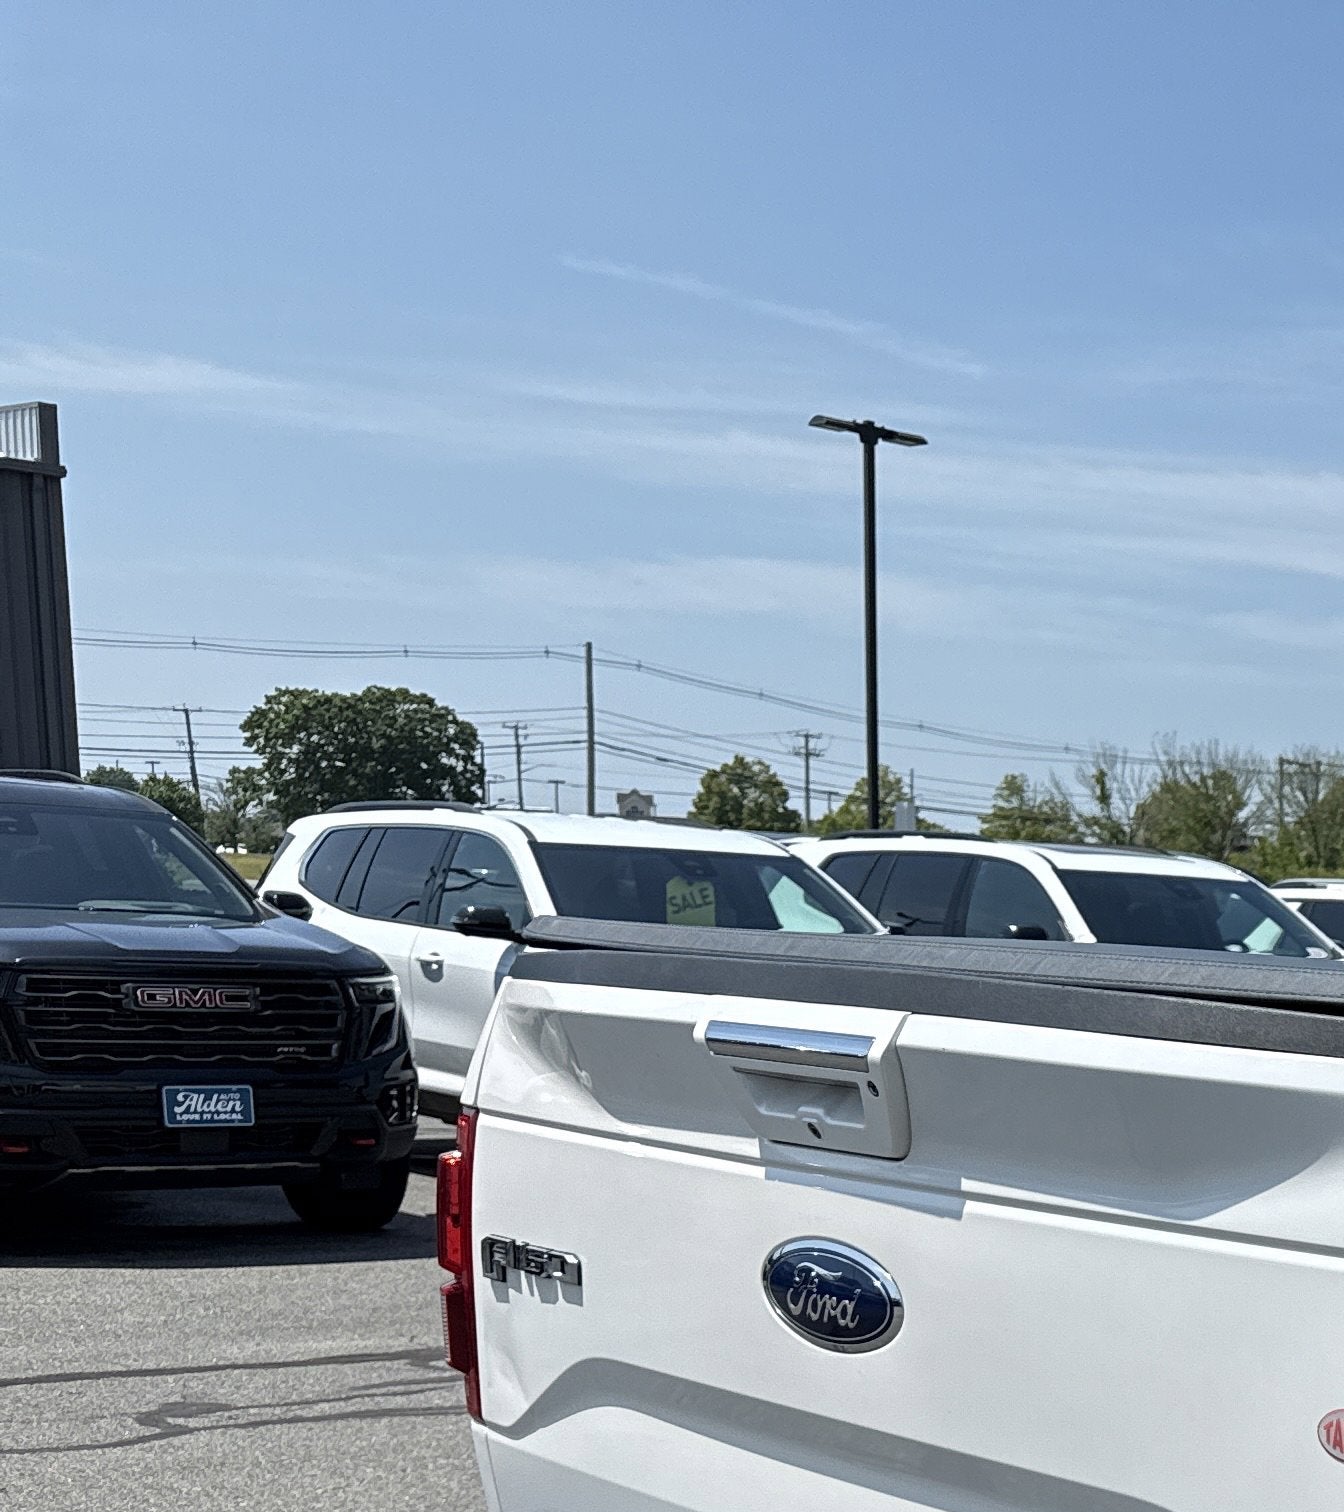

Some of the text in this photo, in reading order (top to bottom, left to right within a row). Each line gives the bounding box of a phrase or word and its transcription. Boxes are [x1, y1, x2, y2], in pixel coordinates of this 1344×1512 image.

[669, 887, 713, 915] SALE
[136, 987, 251, 1009] GMC
[173, 1091, 244, 1114] Alden
[176, 1113, 200, 1121] LOVE
[786, 1261, 862, 1329] Ford
